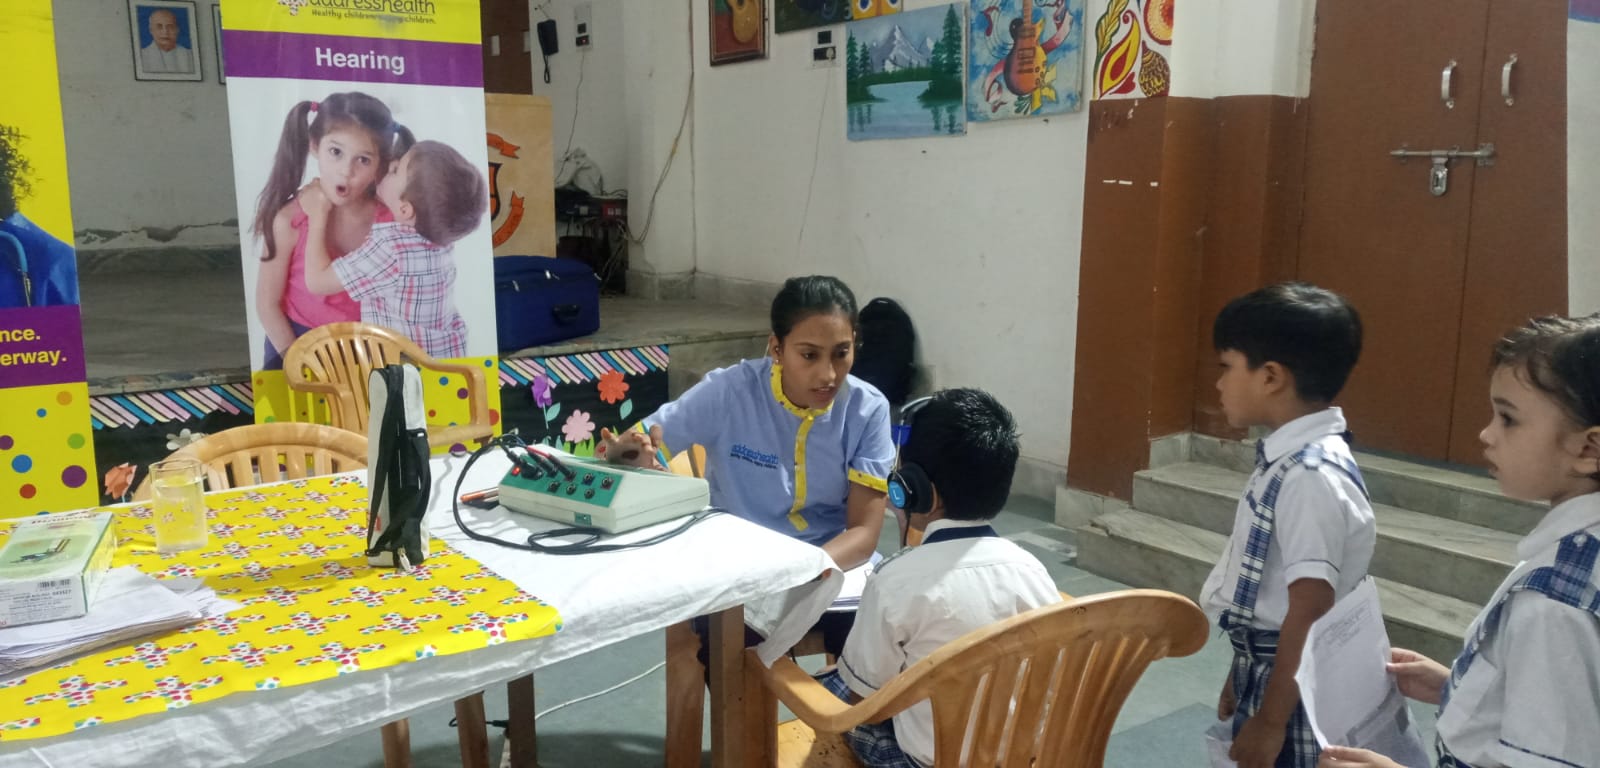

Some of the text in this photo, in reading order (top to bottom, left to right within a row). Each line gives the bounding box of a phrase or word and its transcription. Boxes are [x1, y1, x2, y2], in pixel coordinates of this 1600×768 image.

[312, 9, 342, 19] Healthy
[315, 47, 405, 75] Hearing
[0, 350, 67, 367] erway.
